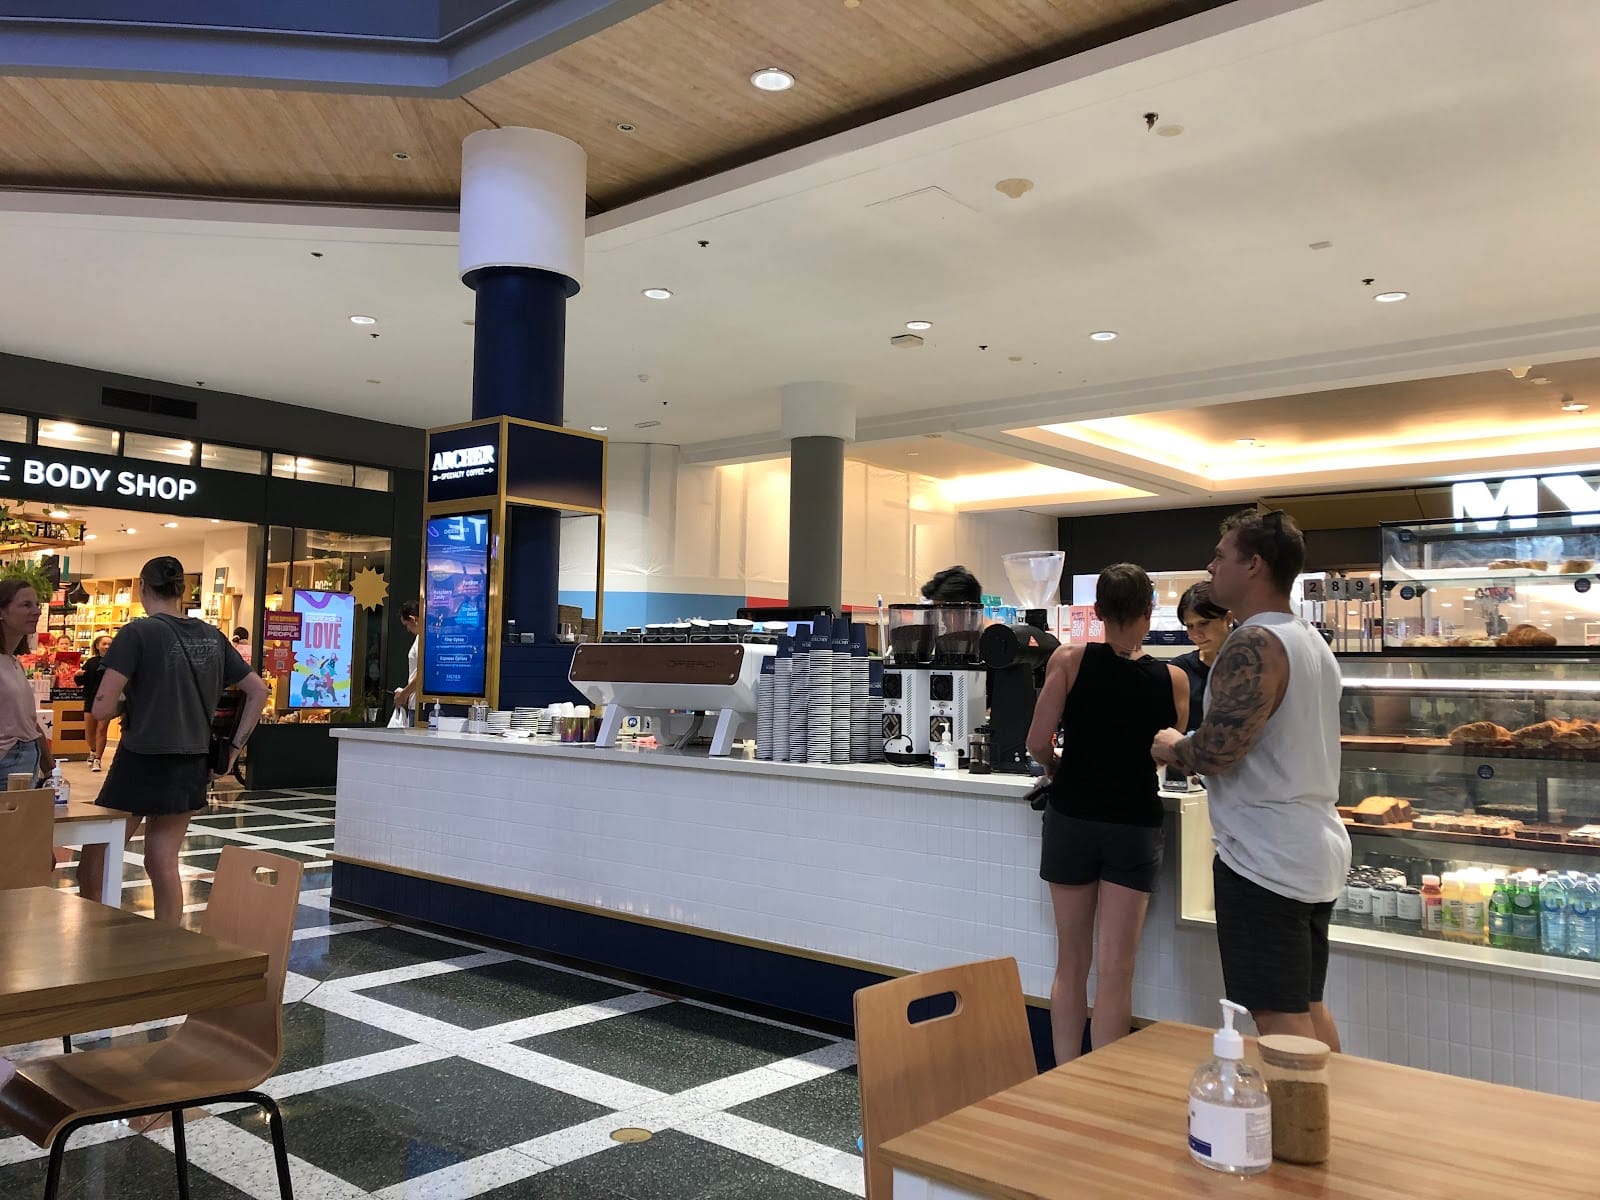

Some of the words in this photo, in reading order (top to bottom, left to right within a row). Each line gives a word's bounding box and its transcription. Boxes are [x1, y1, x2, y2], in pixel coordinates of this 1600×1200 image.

[432, 444, 495, 471] ARCHER
[465, 467, 485, 477] COFFEE
[23, 459, 111, 492] BODY
[116, 471, 197, 501] SHOP
[1309, 582, 1317, 593] 2
[1331, 580, 1340, 592] 8
[1355, 580, 1364, 591] 9
[1370, 582, 1376, 593] 1
[267, 630, 299, 638] PEOPLE
[305, 622, 342, 650] LOVE
